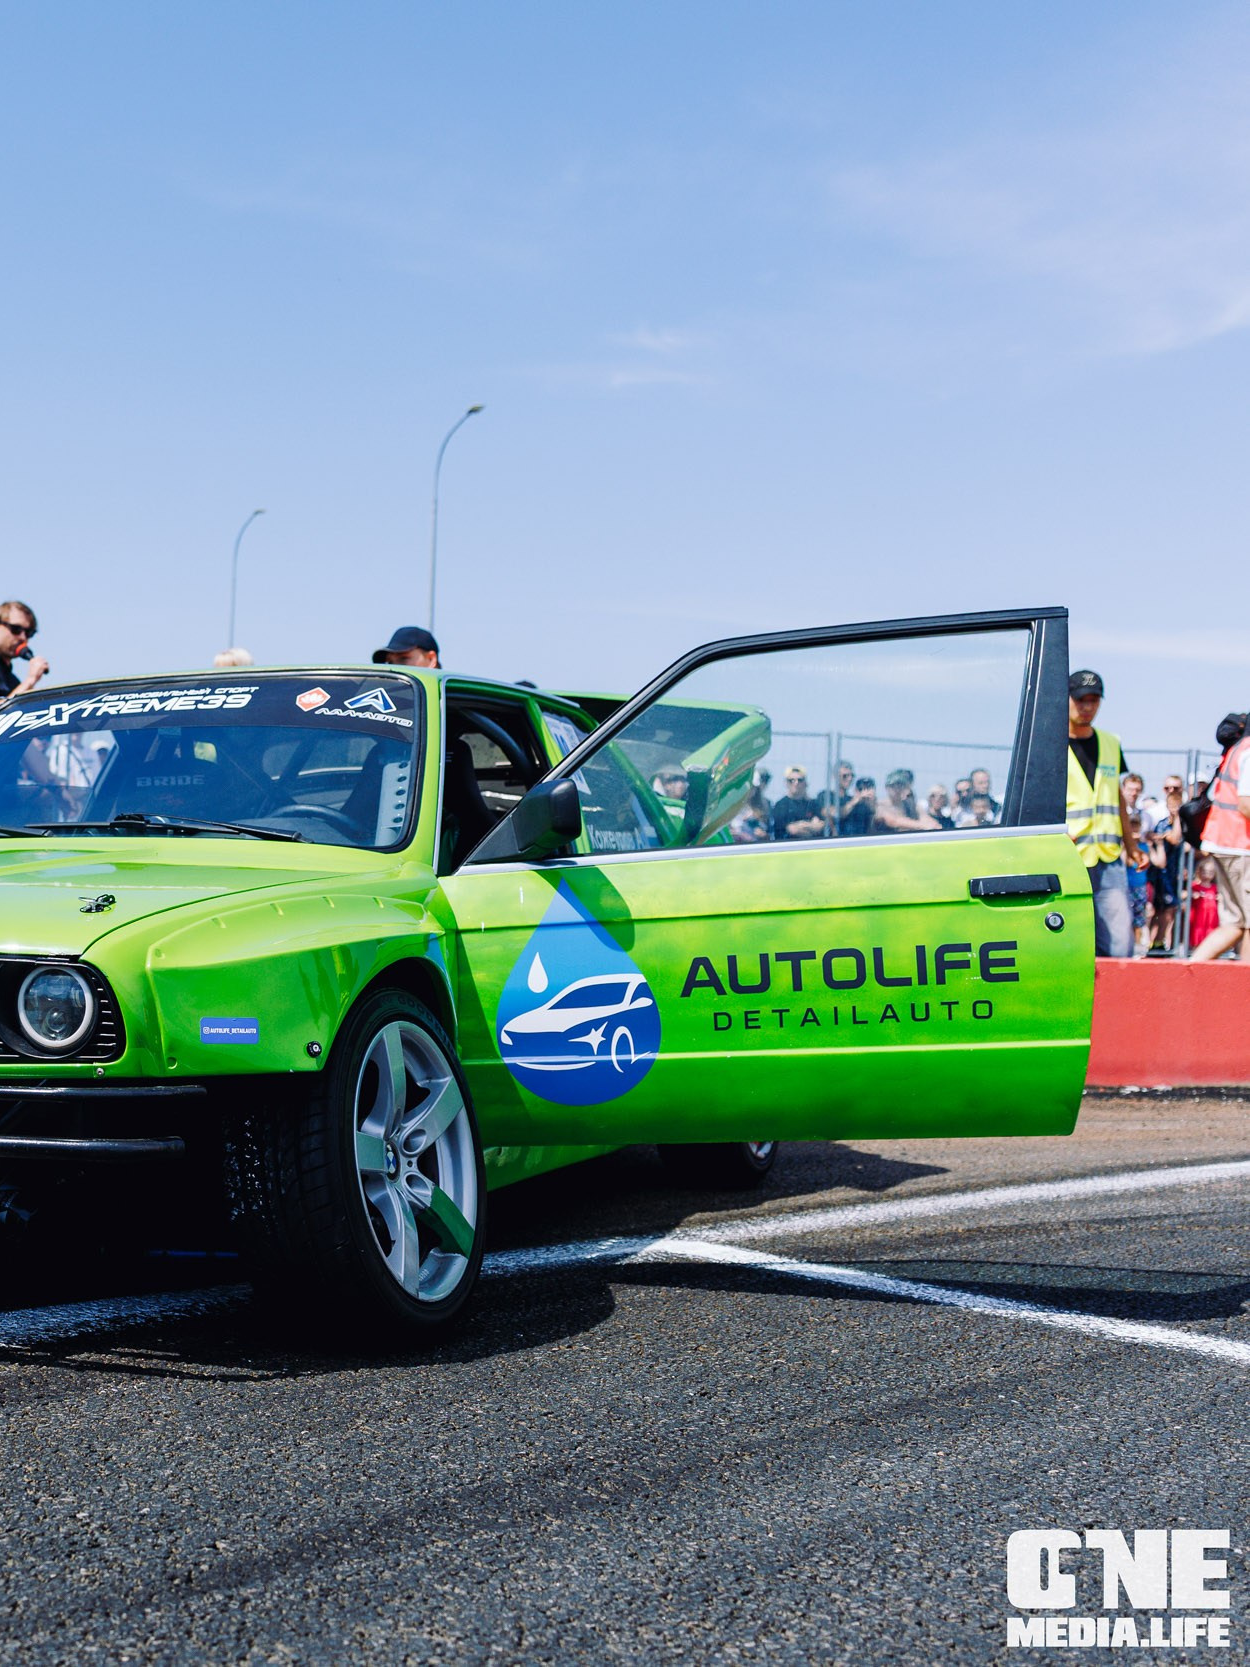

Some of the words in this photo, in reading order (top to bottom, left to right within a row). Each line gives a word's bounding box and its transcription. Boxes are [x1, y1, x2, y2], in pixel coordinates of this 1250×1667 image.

[215, 686, 259, 695] СПОРТ
[136, 775, 205, 787] BRIDE
[680, 940, 1020, 998] AUTOLIFE
[713, 1000, 994, 1031] DETAILAUTO
